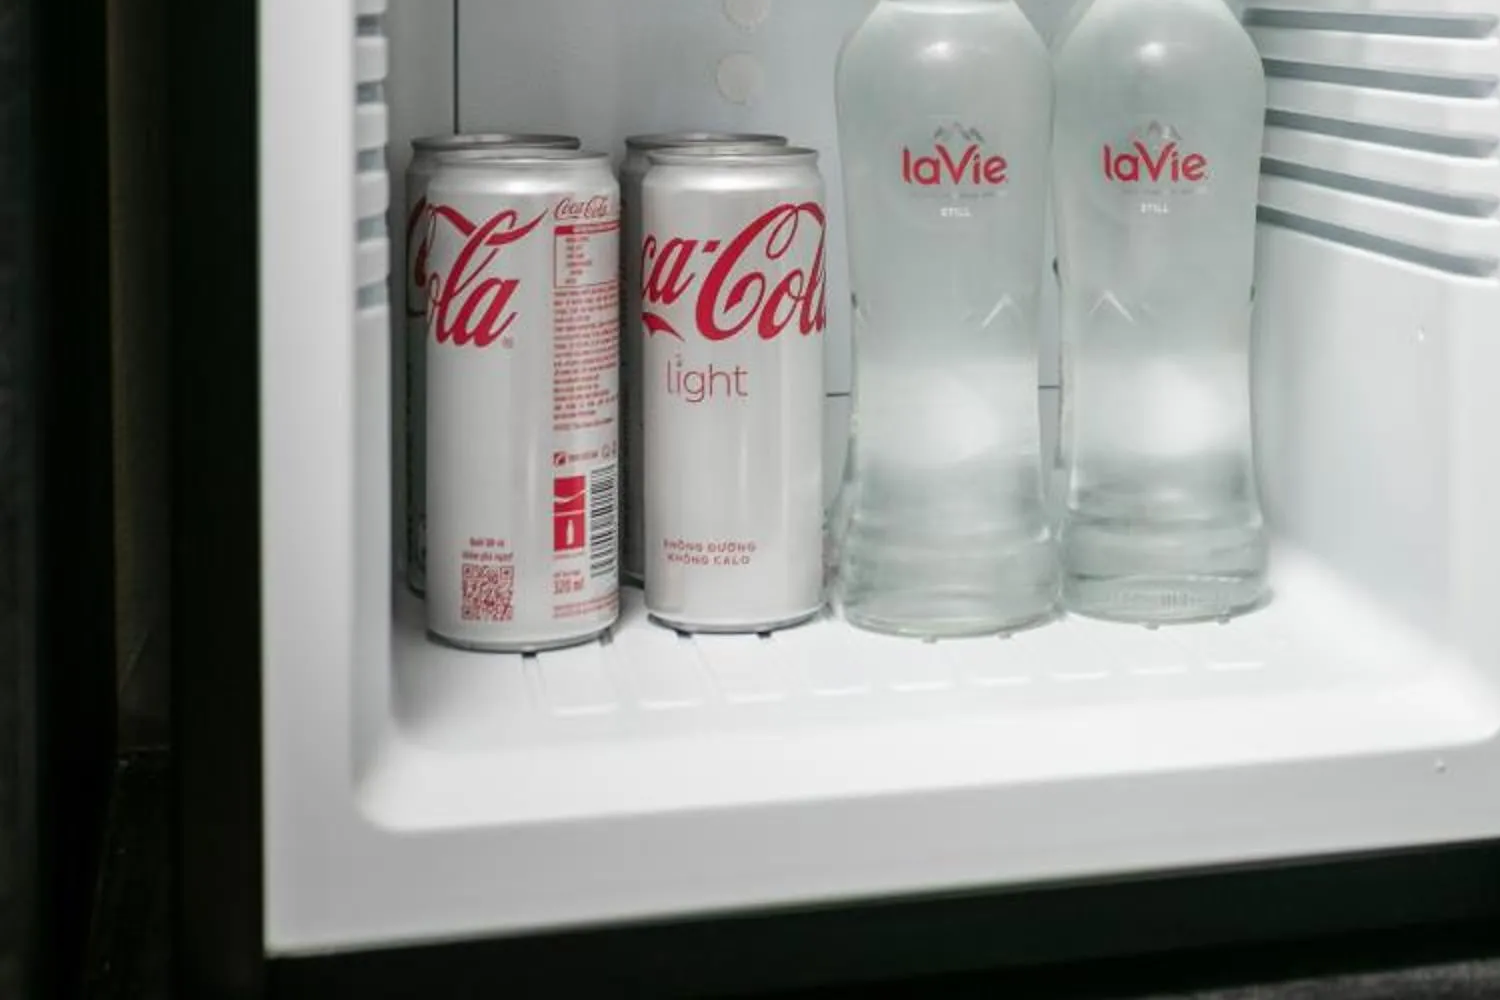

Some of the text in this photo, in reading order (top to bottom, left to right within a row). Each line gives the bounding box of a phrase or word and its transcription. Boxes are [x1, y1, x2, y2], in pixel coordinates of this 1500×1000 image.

[903, 144, 1008, 185] laVie
[1103, 141, 1206, 183] laVie
[666, 356, 749, 403] light
